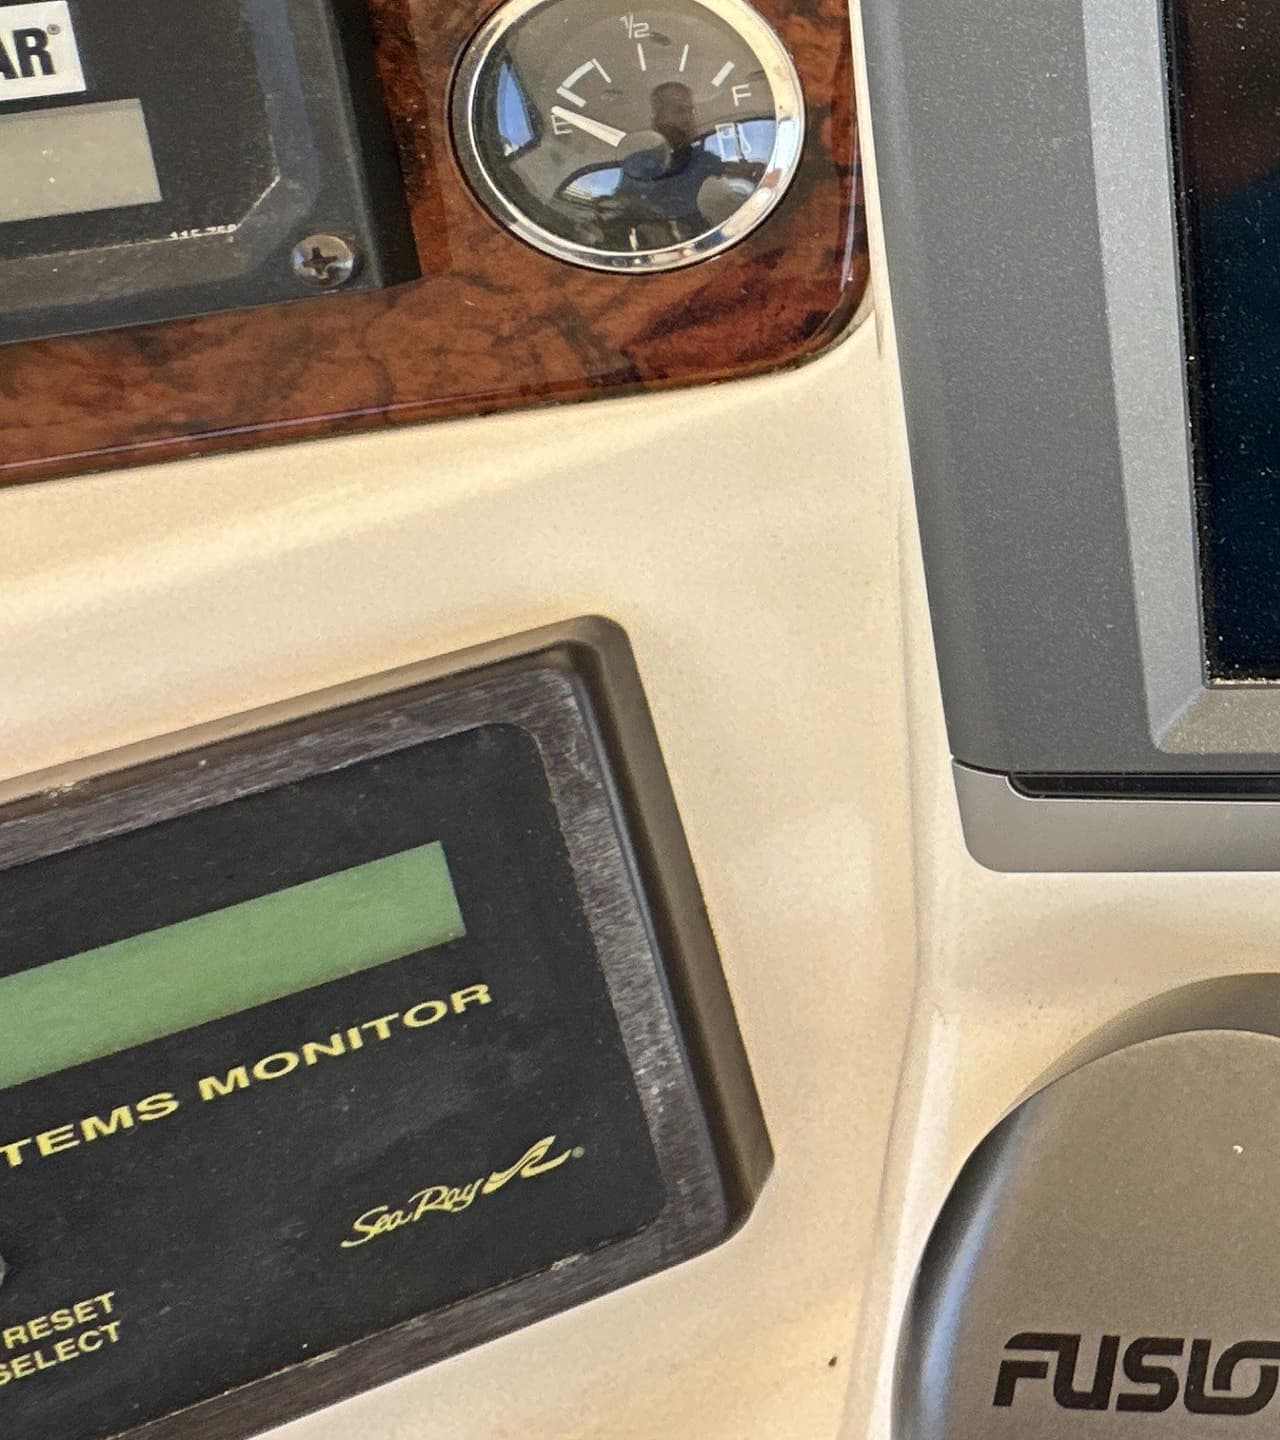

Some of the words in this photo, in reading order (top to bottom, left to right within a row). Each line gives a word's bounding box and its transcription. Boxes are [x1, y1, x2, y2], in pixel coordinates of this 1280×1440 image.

[551, 113, 573, 136] E
[731, 83, 752, 107] F
[0, 1091, 180, 1169] TEMS
[197, 983, 493, 1102] MONITOR
[340, 1205, 413, 1248] Sea
[408, 1177, 485, 1222] Ray
[2, 1291, 116, 1350] RESET
[0, 1320, 122, 1386] SELECT
